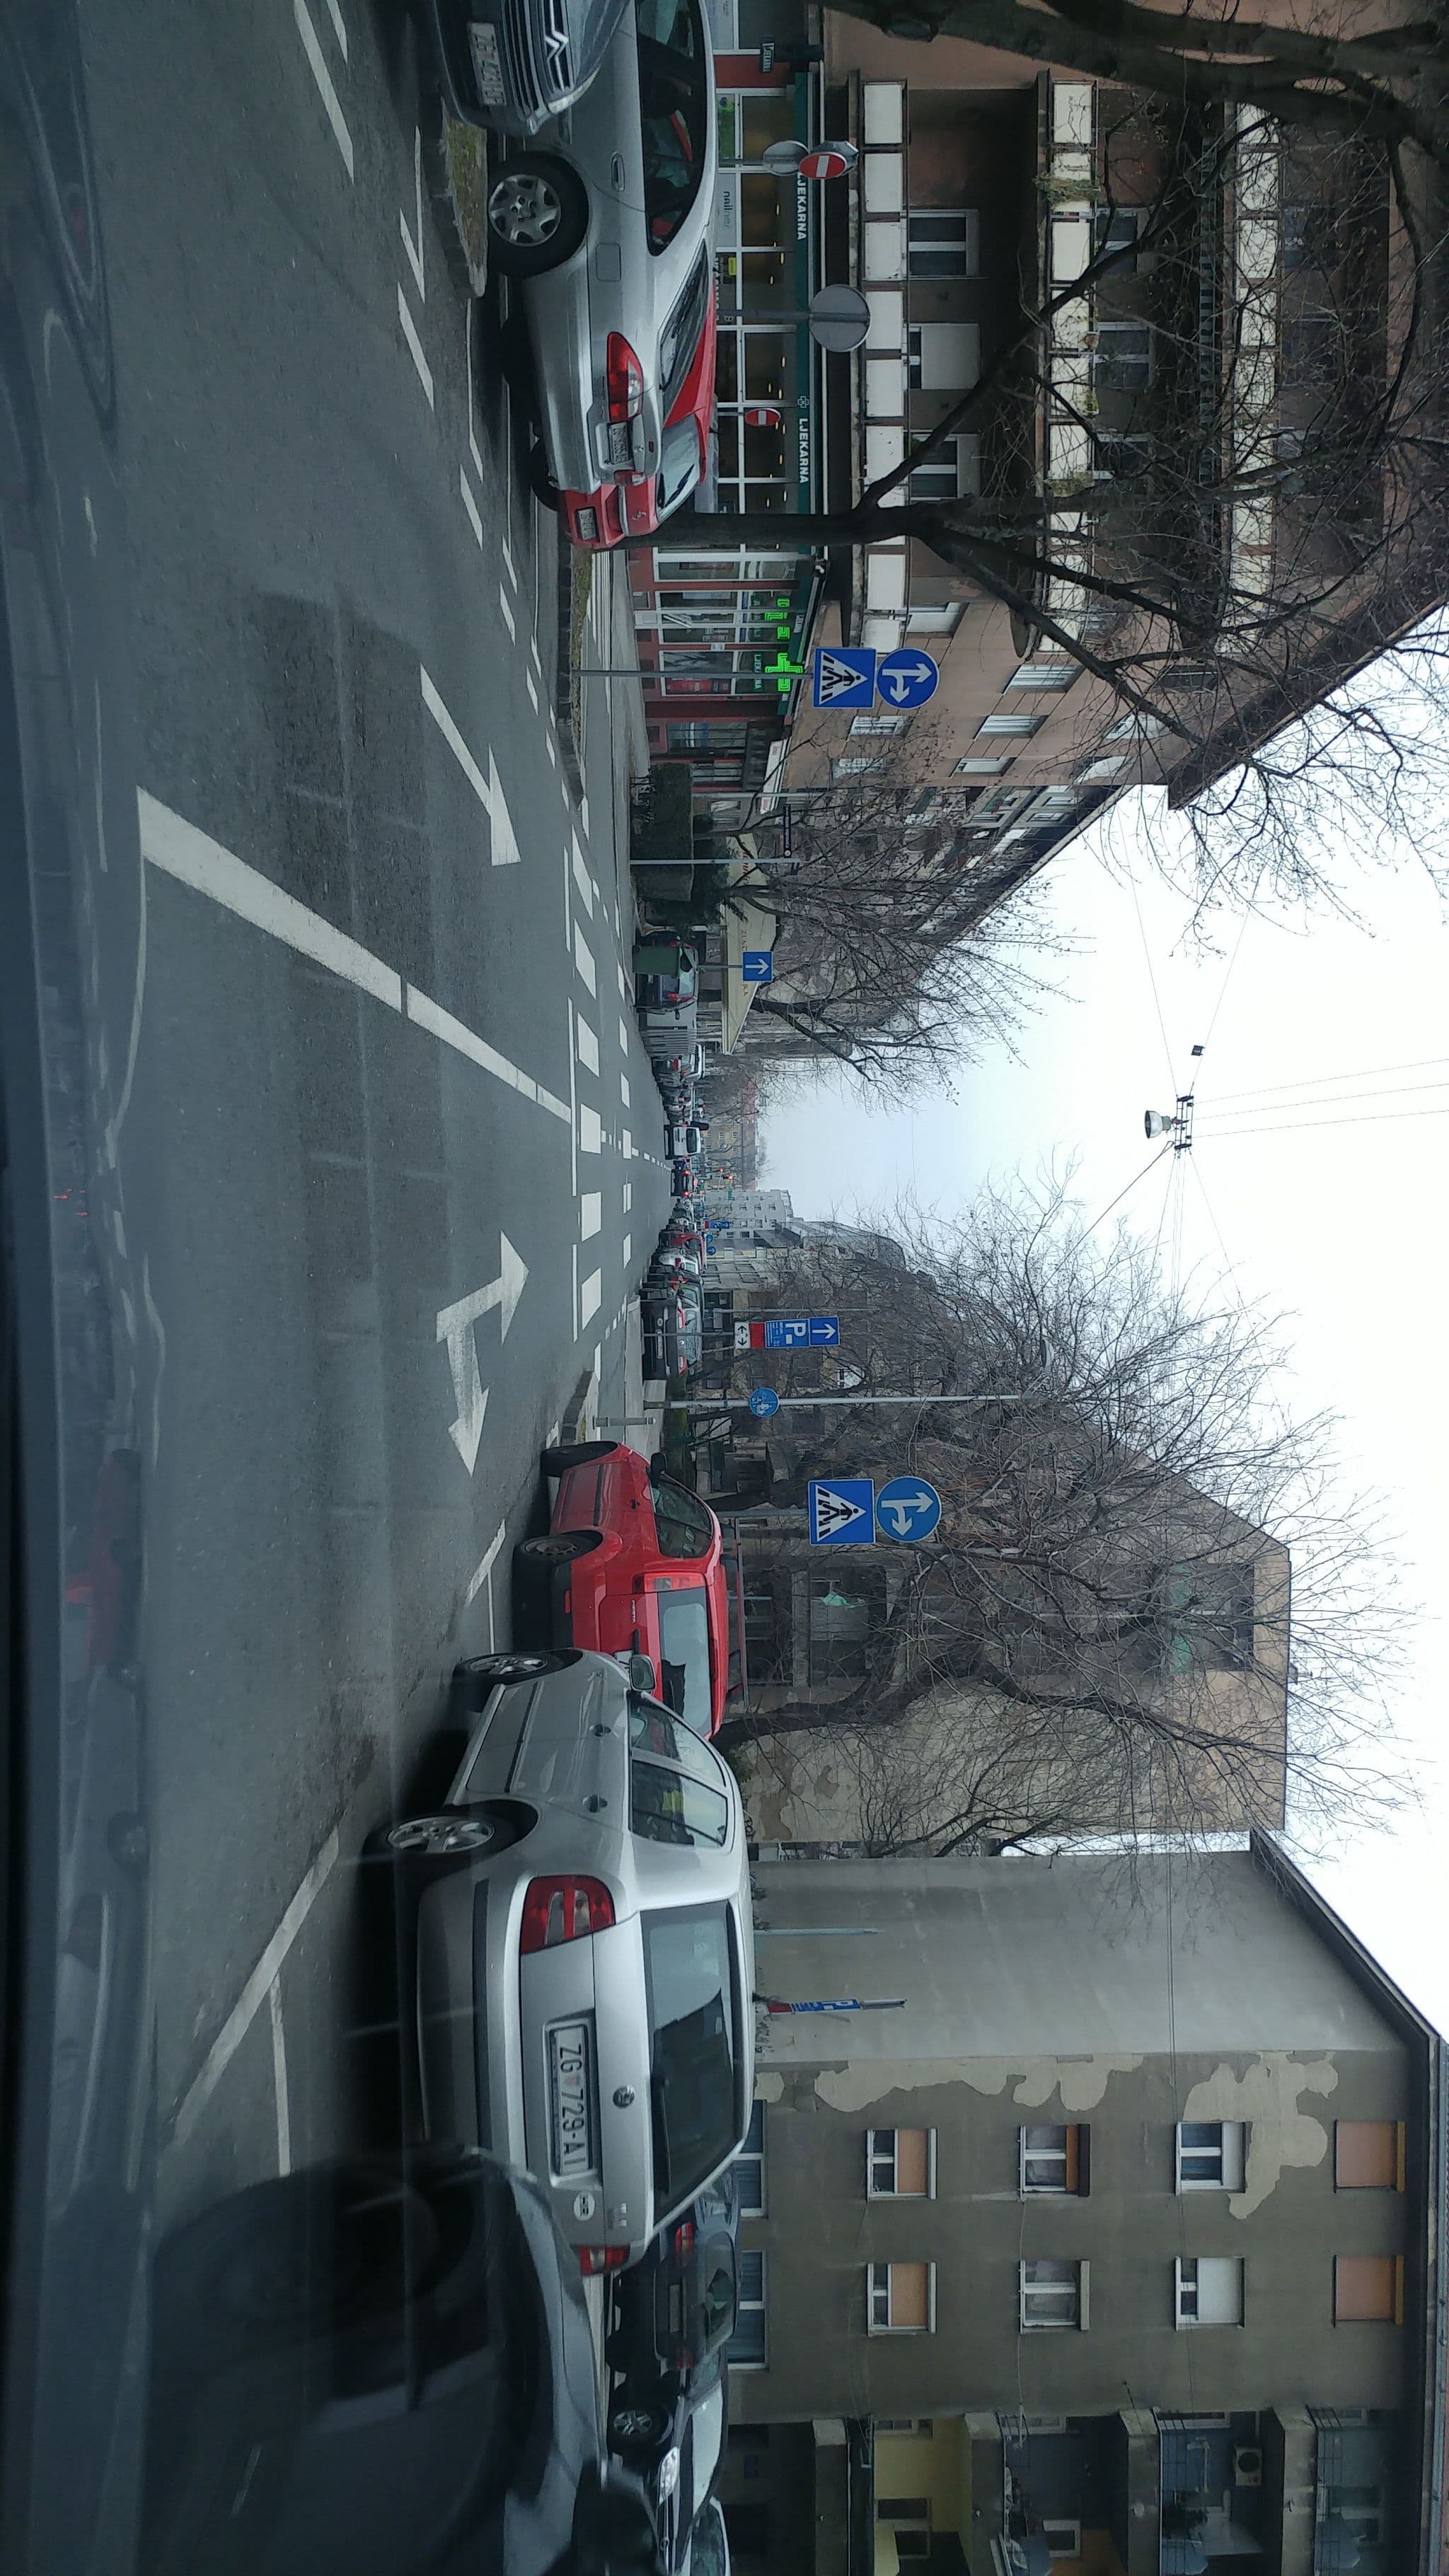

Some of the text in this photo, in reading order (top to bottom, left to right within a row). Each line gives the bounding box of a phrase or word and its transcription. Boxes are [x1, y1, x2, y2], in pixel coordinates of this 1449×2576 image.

[797, 172, 807, 240] LJEKARNA
[799, 418, 809, 483] LJEKARNA
[785, 1323, 806, 1336] P
[560, 2043, 586, 2166] ZG 729-AI
